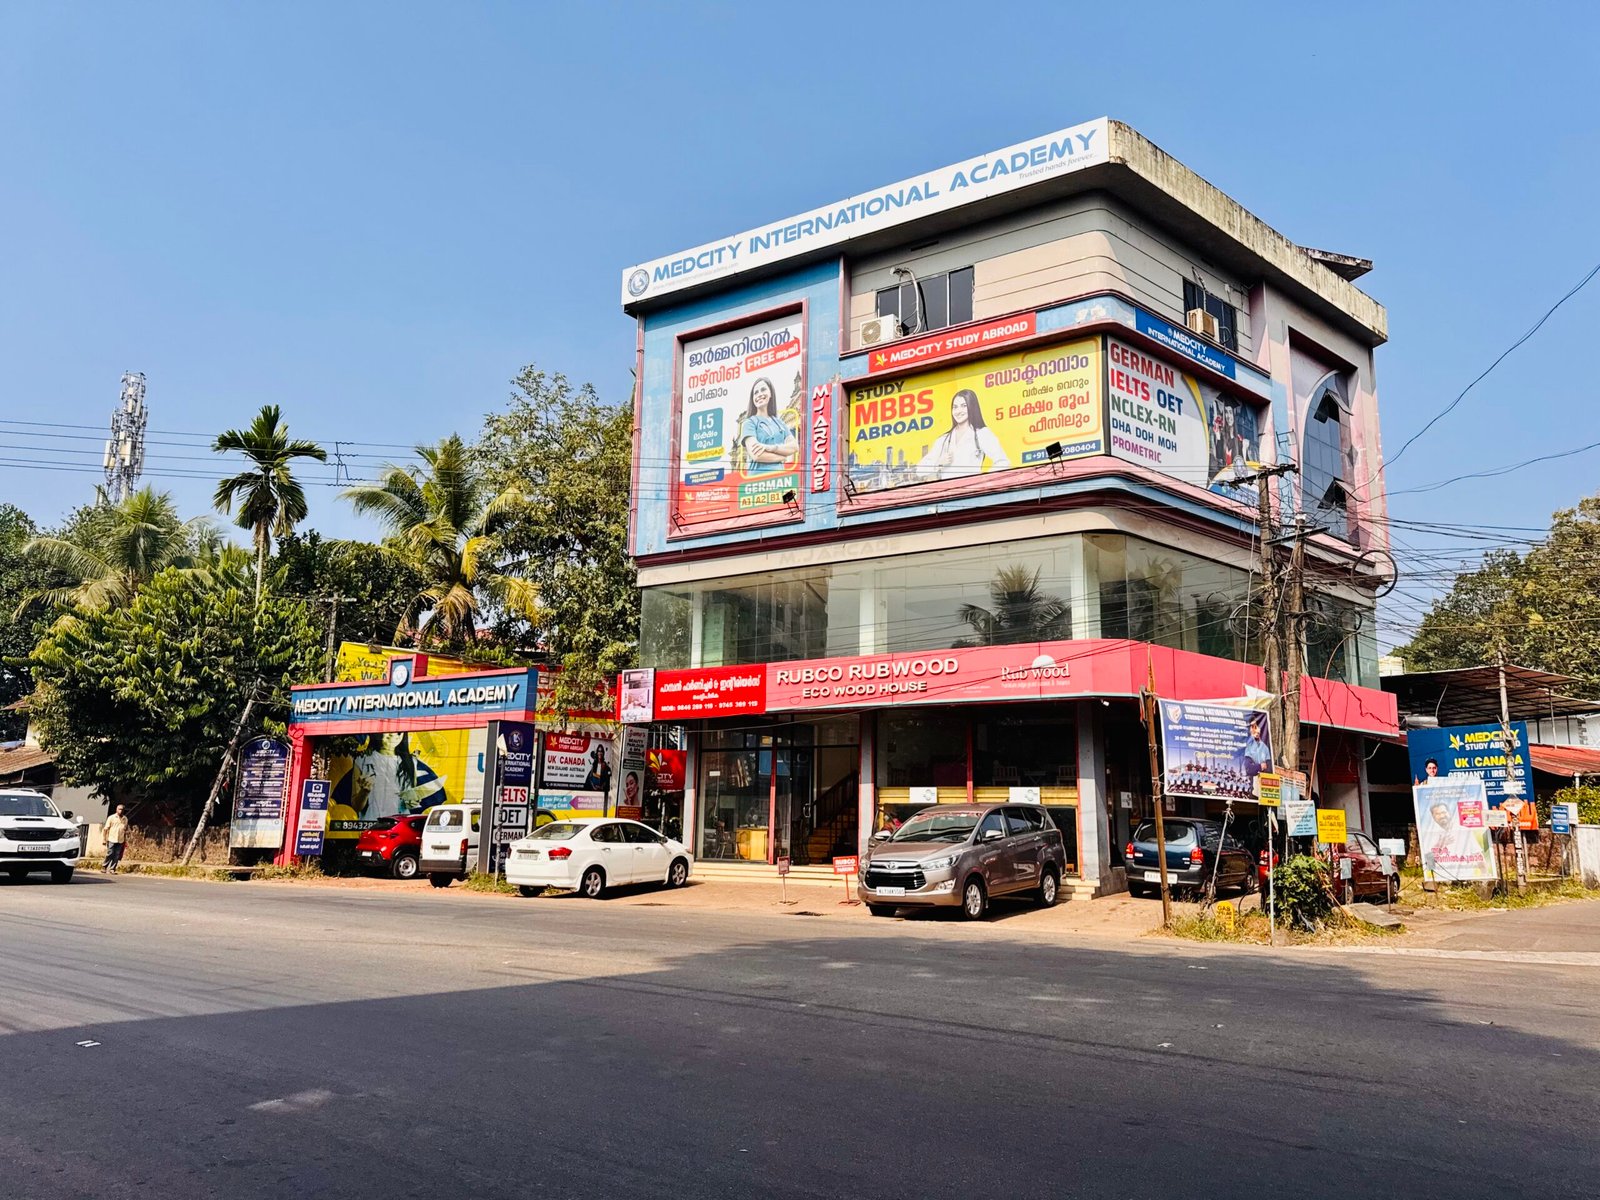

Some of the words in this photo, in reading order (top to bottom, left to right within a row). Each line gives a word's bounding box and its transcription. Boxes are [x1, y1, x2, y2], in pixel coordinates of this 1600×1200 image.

[653, 242, 743, 282] MEDCITY
[750, 181, 939, 254] INTERNATIONAL
[949, 129, 1097, 191] ACADEMY
[889, 341, 943, 363] MEDCITY
[946, 333, 980, 349] STUDY
[982, 320, 1028, 341] ABROAD
[1147, 327, 1196, 357] INTERNATIONAL
[1197, 353, 1226, 372] ACADEMY
[1173, 330, 1207, 354] MEDCITY
[748, 351, 775, 369] FREE
[1110, 343, 1174, 388] GERMAN
[856, 381, 905, 401] STUDY
[1110, 368, 1150, 401] IELTS
[1157, 389, 1183, 415] OET
[855, 389, 934, 427] MBBS
[995, 407, 1004, 421] 5
[1009, 400, 1053, 418] ലക്ഷം
[1059, 391, 1090, 410] രൂപ
[1111, 394, 1176, 435] NCLEX-RN
[698, 413, 714, 430] 1.5
[856, 416, 934, 442] ABROAD
[1112, 417, 1131, 435] DHA
[1135, 427, 1154, 443] DOH
[1158, 436, 1177, 452] MOH
[1112, 435, 1162, 463] PROMETRIC
[745, 476, 792, 494] GERMAN
[742, 498, 751, 506] A1
[756, 496, 766, 504] A2
[770, 493, 780, 501] B1
[776, 666, 843, 685] RUBCO
[849, 658, 959, 680] RUBWOOD
[1001, 665, 1028, 681] Rub
[1032, 663, 1070, 679] wood
[294, 696, 345, 714] MEDCITY
[346, 690, 443, 711] INTERNATIONAL
[447, 684, 518, 704] ACADEMY
[803, 687, 831, 698] ECO
[834, 684, 876, 697] WOOD
[879, 681, 928, 694] HOUSE
[559, 736, 584, 745] MEDCITY
[547, 755, 557, 763] UK
[560, 756, 585, 766] CANADA
[1454, 758, 1469, 768] UK
[1474, 754, 1524, 767] CANAA
